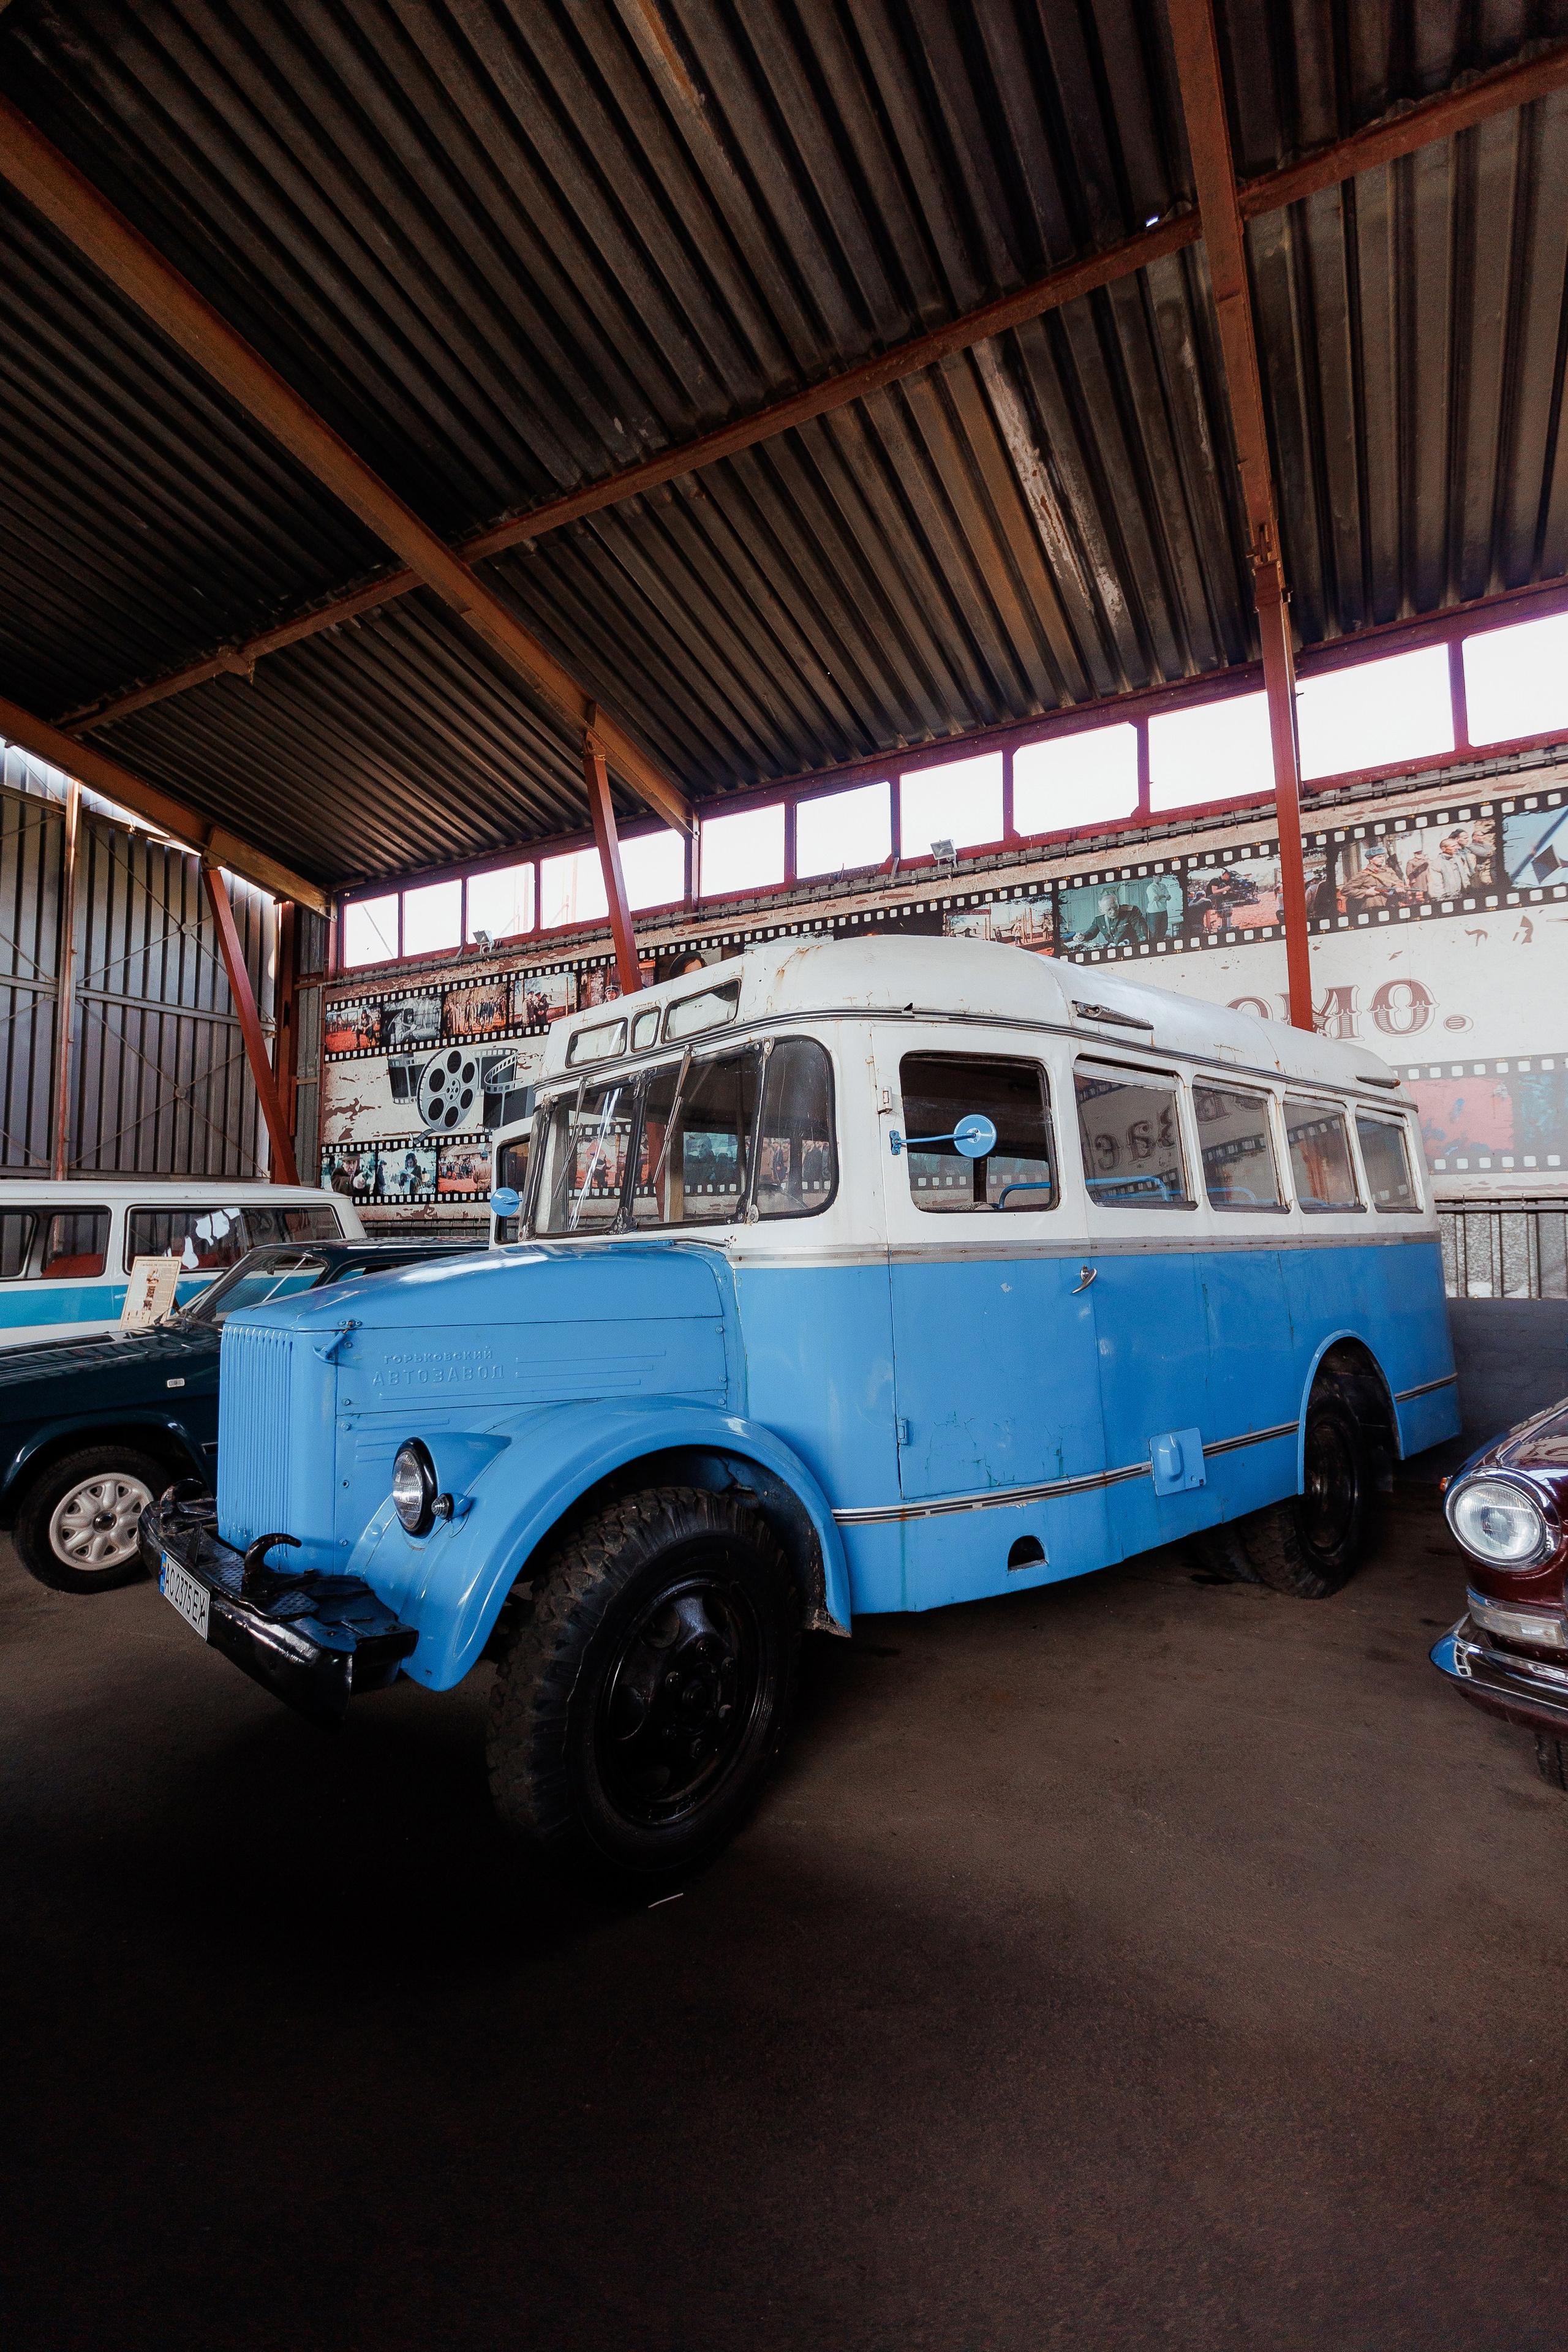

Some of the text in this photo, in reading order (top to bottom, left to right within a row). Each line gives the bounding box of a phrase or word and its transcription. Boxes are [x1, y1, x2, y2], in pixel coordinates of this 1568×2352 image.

[384, 1346, 492, 1364] ГОРЬКОВСКИЙ
[372, 1363, 504, 1387] АВТОЗАВОД
[165, 1563, 175, 1596] AC
[175, 1573, 192, 1615] 2375
